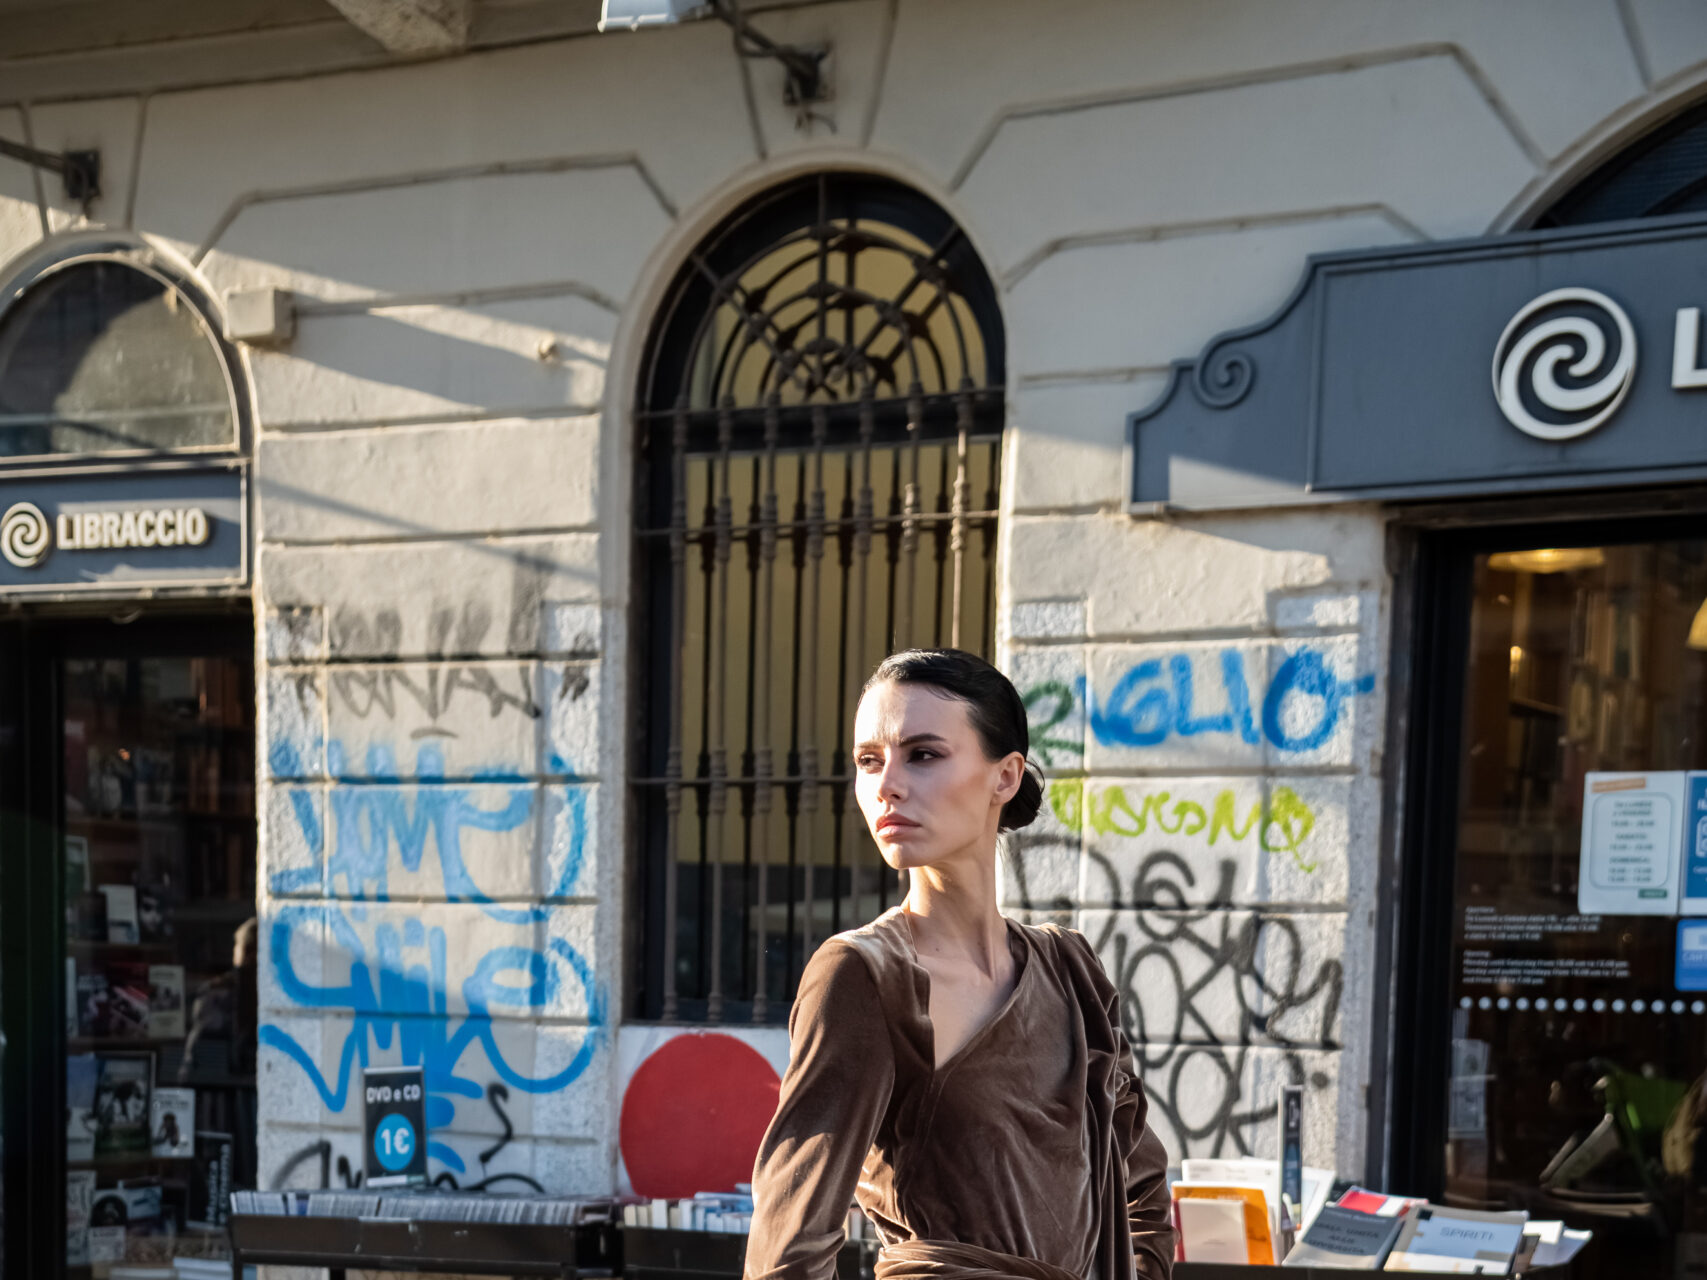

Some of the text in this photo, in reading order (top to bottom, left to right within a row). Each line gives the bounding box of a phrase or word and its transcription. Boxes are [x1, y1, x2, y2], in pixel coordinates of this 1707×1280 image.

[57, 508, 208, 549] LIBRACCIO
[366, 1084, 421, 1104] DVD e CD
[381, 1127, 410, 1156] 1€
